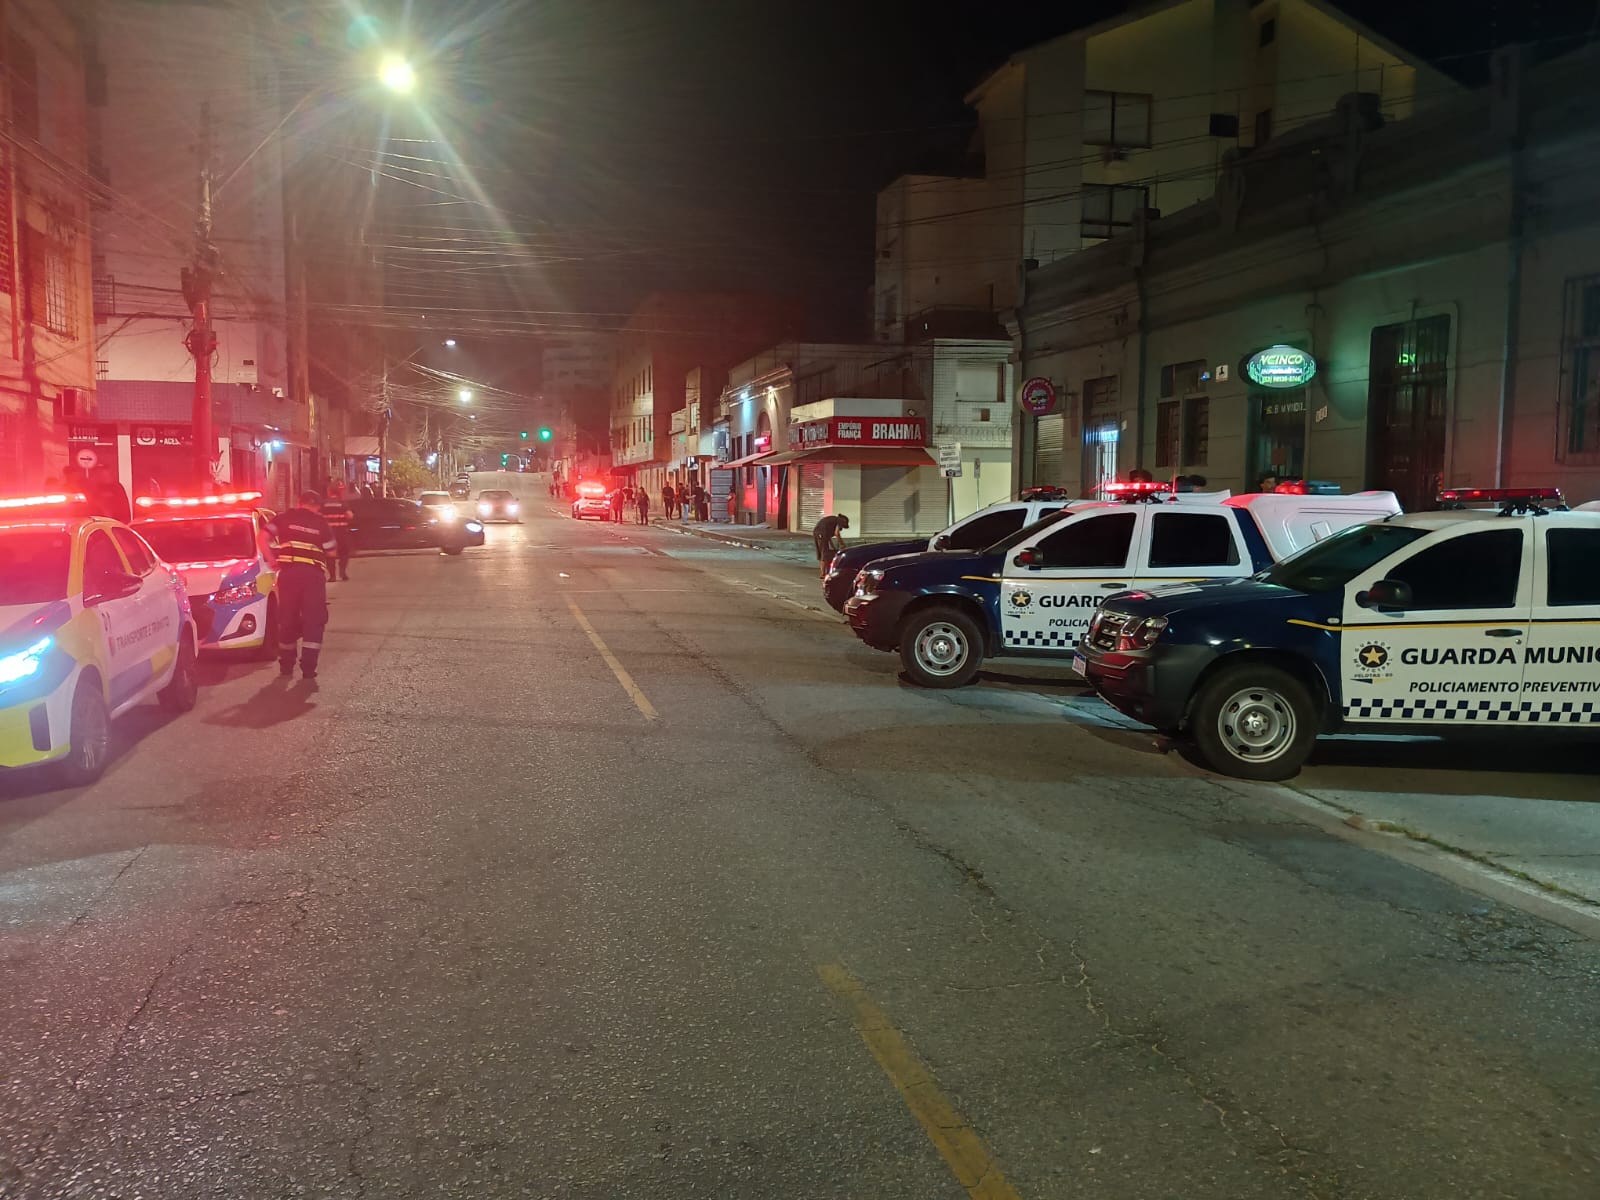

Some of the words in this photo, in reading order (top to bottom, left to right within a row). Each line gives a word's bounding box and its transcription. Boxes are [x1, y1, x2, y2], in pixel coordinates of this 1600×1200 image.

[1260, 354, 1303, 366] VCINCO
[838, 421, 862, 430] EMPÓRIO
[872, 423, 922, 440] BRAHMA
[838, 430, 862, 440] FRANÇA
[1401, 648, 1517, 665] GUARDA
[1409, 681, 1519, 693] POLICIAMENTO
[1522, 681, 1600, 692] PREVENTIV
